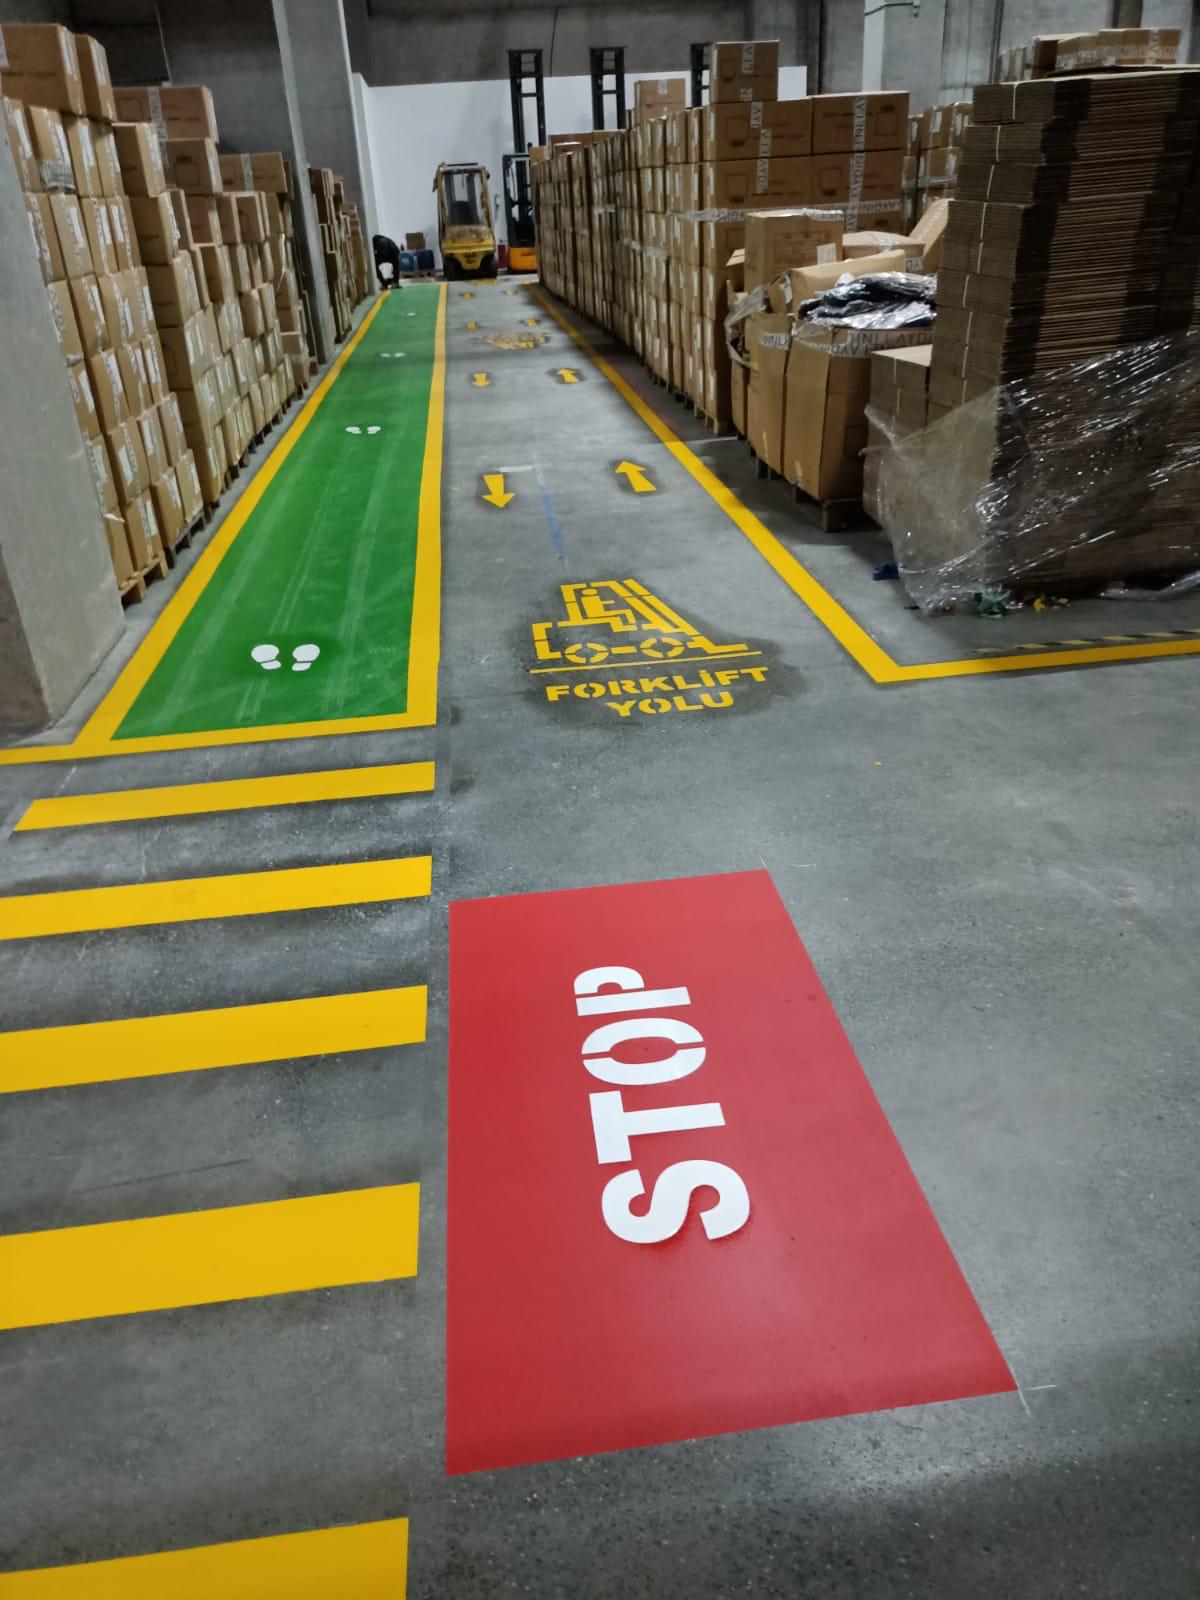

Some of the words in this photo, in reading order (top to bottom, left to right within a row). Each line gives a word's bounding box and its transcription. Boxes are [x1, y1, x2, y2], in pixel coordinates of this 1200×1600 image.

[546, 666, 768, 703] FORKLİFT
[605, 690, 736, 718] YOLU
[574, 966, 750, 1244] STOP
